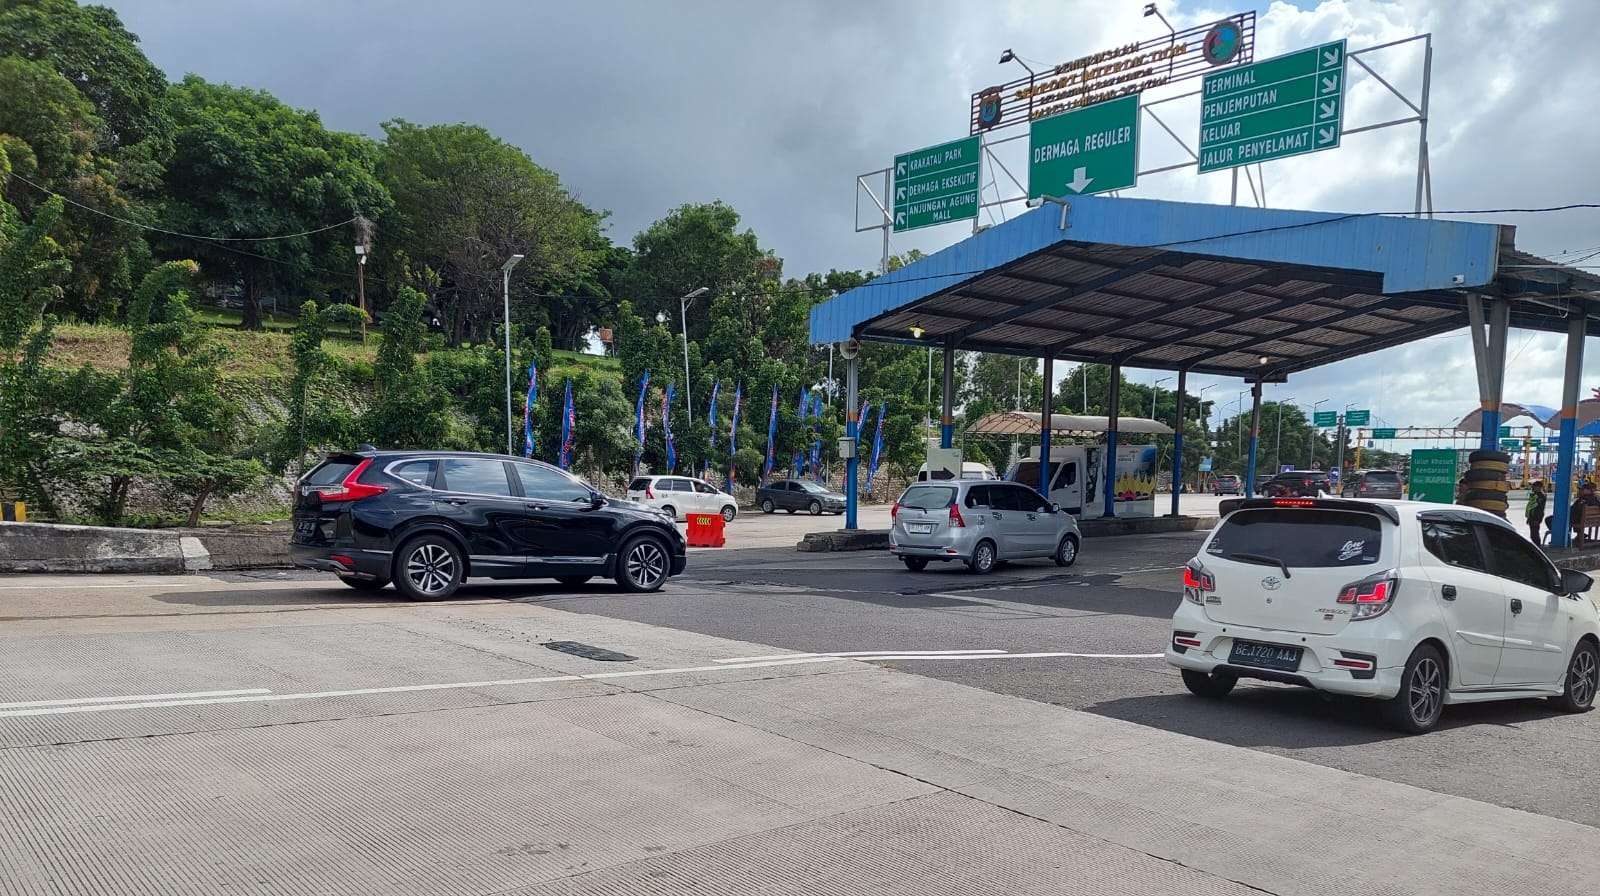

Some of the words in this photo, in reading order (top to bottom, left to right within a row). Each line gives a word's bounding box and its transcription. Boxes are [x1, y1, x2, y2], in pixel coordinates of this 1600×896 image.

[1205, 70, 1256, 95] TERMINAL
[1204, 89, 1278, 119] PENJEMPUTAN
[1034, 138, 1080, 164] DERMAGA
[1084, 126, 1131, 152] REGULER
[1202, 122, 1241, 143] KELUAR
[910, 152, 942, 170] KRAKATAU
[945, 147, 962, 162] PARK
[1202, 148, 1233, 166] JALUR
[1238, 132, 1309, 159] PENYELAMAT
[909, 180, 939, 197] DERMAGA
[941, 172, 976, 188] EKSEKUTIF
[909, 198, 947, 215] ANJUNGAN
[950, 193, 976, 207] AGUNG
[933, 210, 951, 221] MALL
